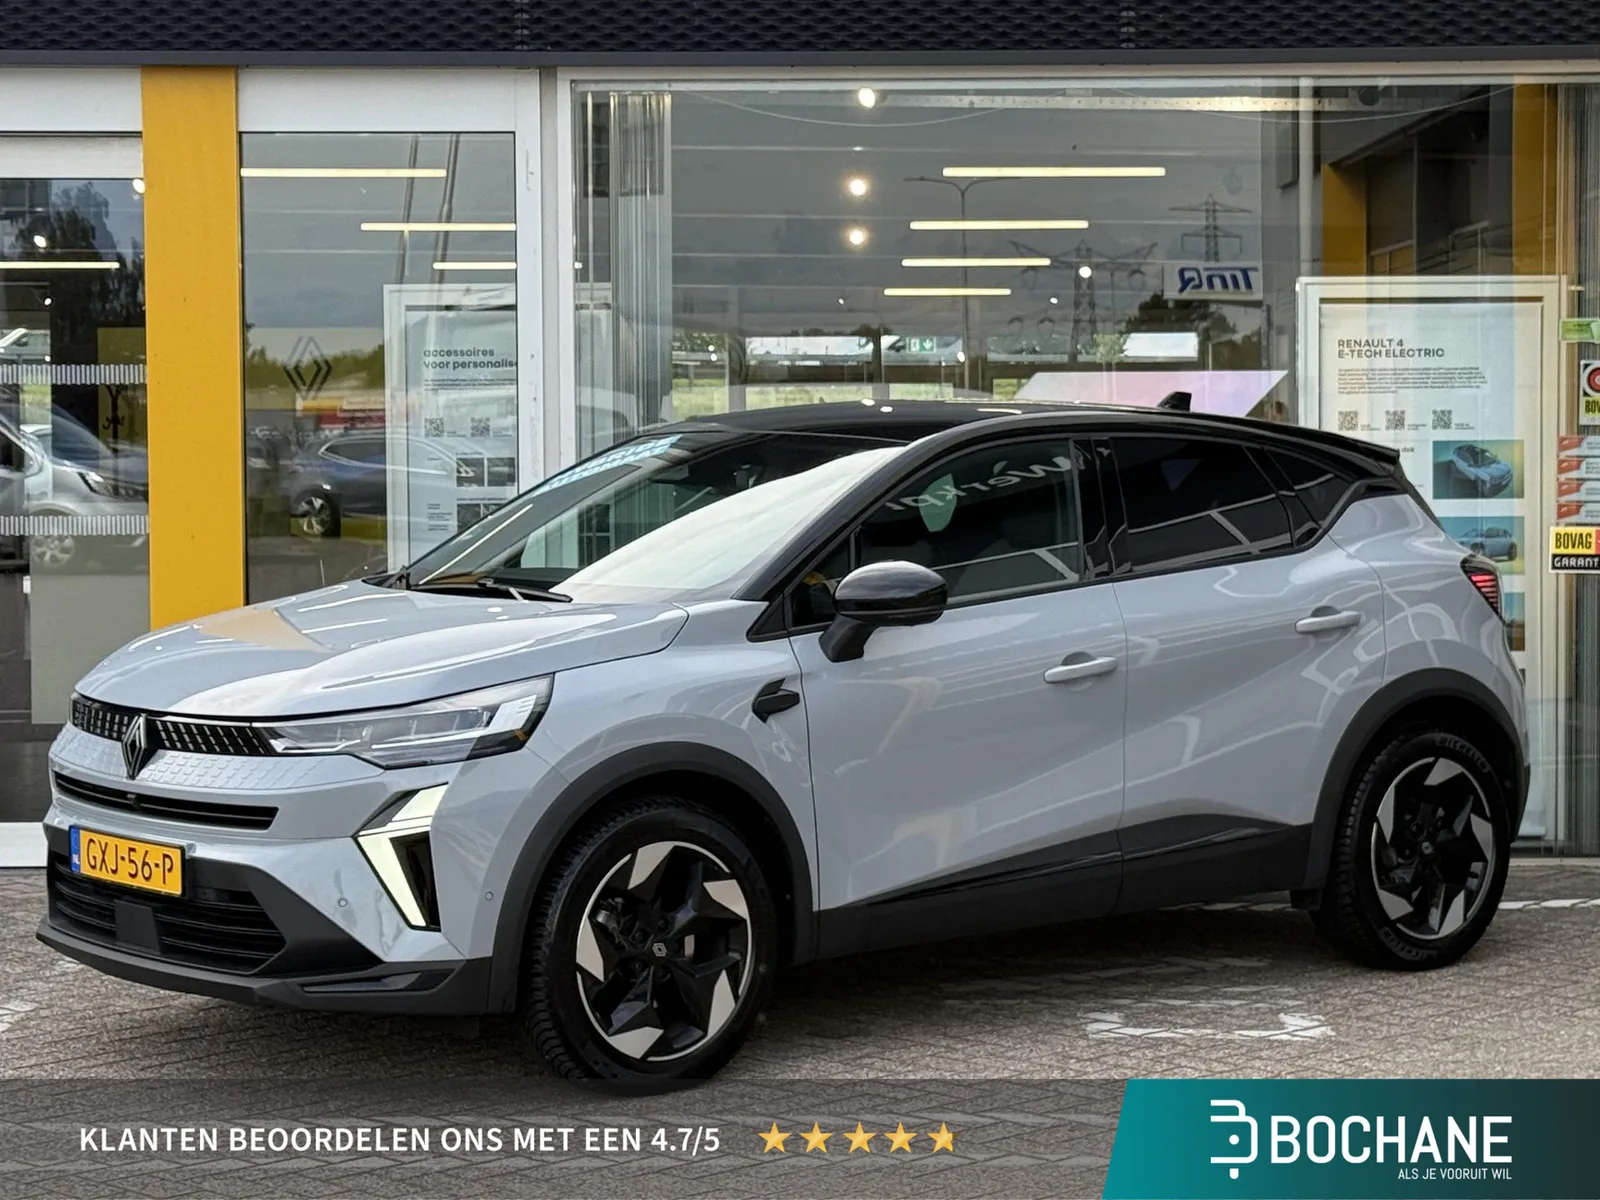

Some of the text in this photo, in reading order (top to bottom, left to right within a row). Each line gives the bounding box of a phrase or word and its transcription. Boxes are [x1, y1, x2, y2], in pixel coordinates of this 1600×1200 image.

[1338, 339, 1404, 348] RENAULT 4
[424, 347, 494, 357] accessoires
[1338, 349, 1445, 359] E-TECH ELECTRIC
[424, 360, 450, 369] voor
[1555, 532, 1592, 549] BOVAG
[1554, 557, 1600, 568] GARANT
[86, 838, 174, 885] GXJ-56-P
